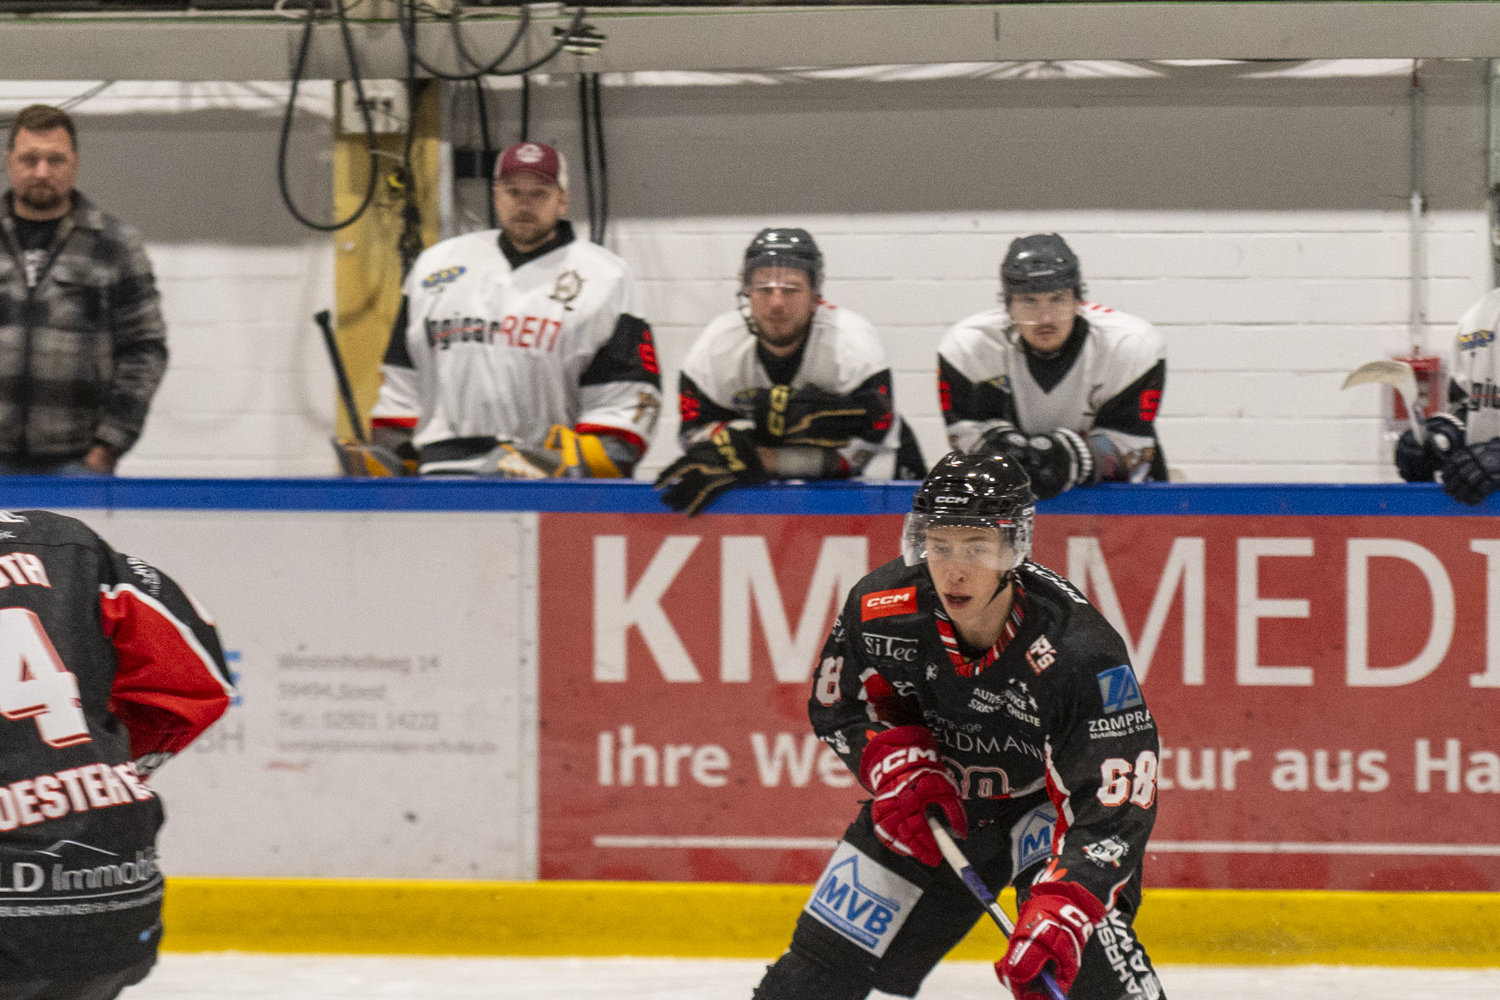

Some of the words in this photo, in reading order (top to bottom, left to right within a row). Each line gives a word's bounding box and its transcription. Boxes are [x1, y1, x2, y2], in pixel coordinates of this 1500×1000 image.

[866, 593, 910, 609] CCM
[598, 724, 732, 787] Ihre
[1270, 748, 1390, 791] aus
[1097, 750, 1159, 811] 68
[819, 874, 894, 936] MVB
